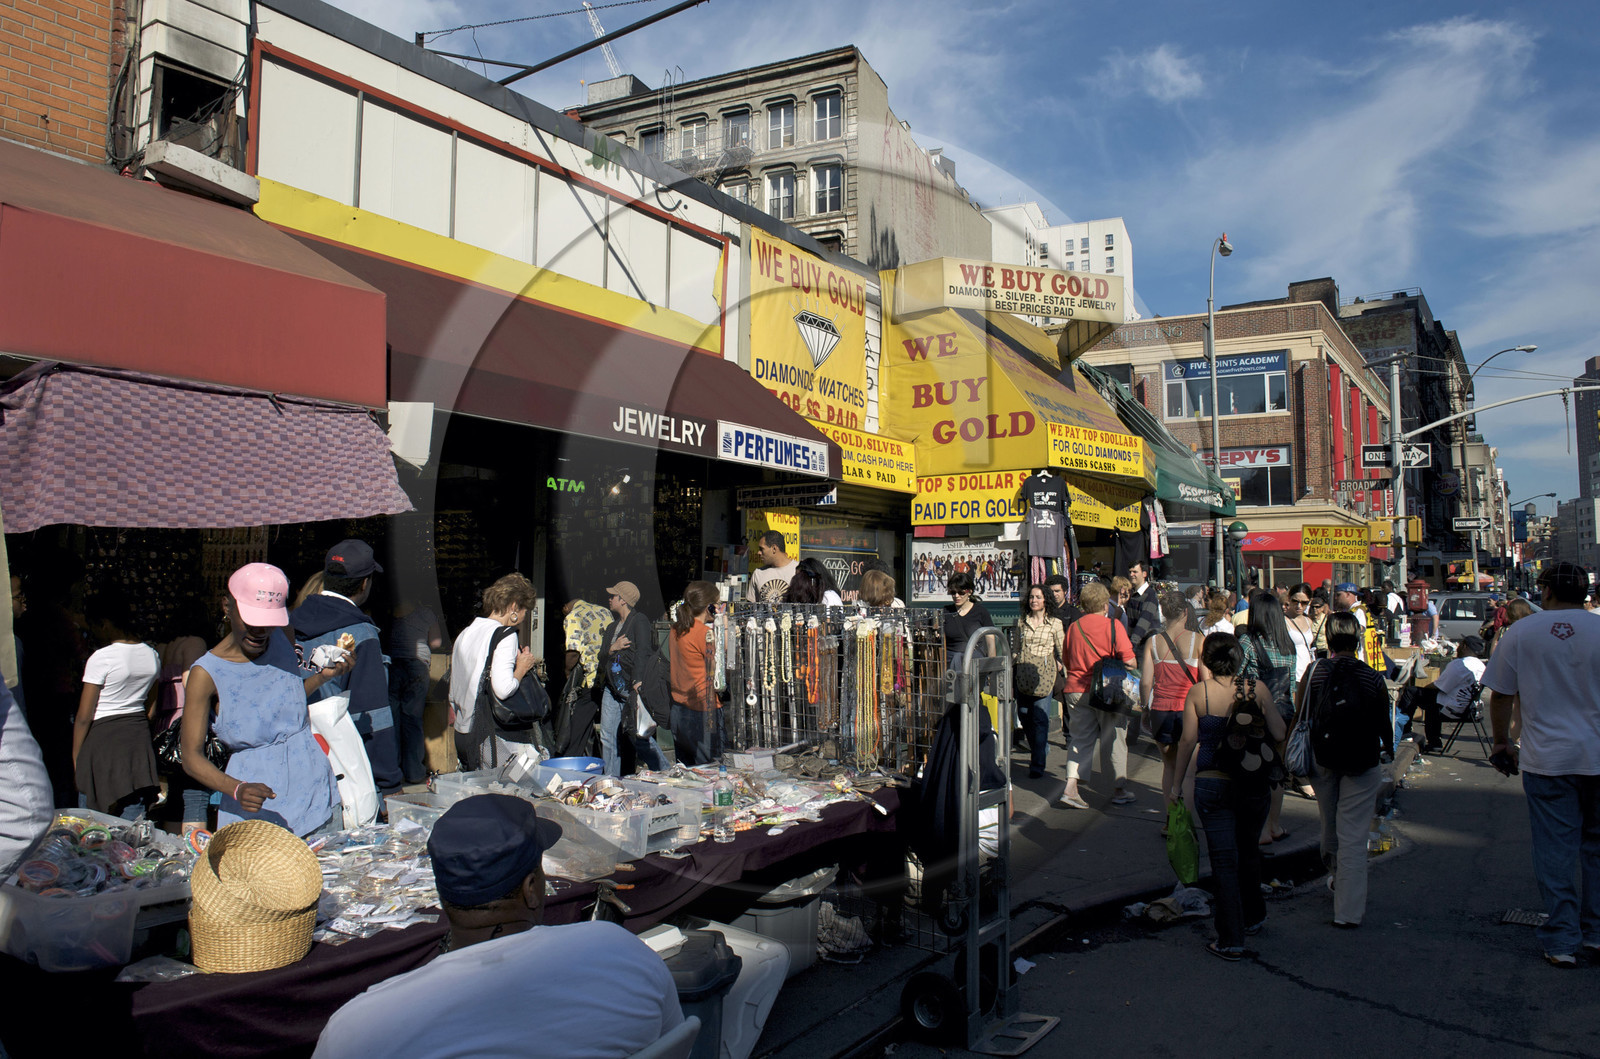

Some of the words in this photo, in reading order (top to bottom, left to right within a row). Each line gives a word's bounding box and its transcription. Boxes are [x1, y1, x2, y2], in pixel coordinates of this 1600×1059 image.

[756, 239, 784, 283] WE
[790, 254, 820, 297] BUY
[828, 271, 864, 316] GOLD
[959, 264, 995, 288] WE
[1001, 268, 1045, 293] BUY
[1051, 274, 1109, 299] GOLD
[949, 285, 998, 298] DIAMONDS
[1005, 291, 1036, 303] SILVER
[1043, 295, 1076, 307] ESTATE
[1078, 299, 1117, 311] JEWELRY
[995, 300, 1017, 311] BEST
[1020, 303, 1051, 314] PRICES
[1053, 307, 1074, 317] PAID
[902, 332, 958, 361] WE
[1190, 362, 1207, 370] FIVE
[1209, 359, 1238, 369] OINTS
[1239, 355, 1280, 366] ACADEMY
[756, 358, 815, 392] DIAMONDS
[819, 376, 865, 408] WATCHES
[912, 377, 988, 408] BUY
[612, 406, 707, 447] JEWELRY
[827, 404, 858, 430] PAID
[932, 411, 1036, 444] GOLD
[1050, 423, 1063, 437] WE
[1065, 426, 1081, 439] PAY
[1083, 429, 1098, 441] TOP
[734, 430, 810, 470] PERFUMES
[832, 430, 904, 457] GOLD,SILVER
[1053, 439, 1070, 453] FOR
[1072, 442, 1094, 456] GOLD
[1095, 446, 1132, 462] DIAMONDS
[841, 449, 856, 463] UM,
[856, 453, 877, 466] CASH
[879, 457, 895, 469] PAID
[896, 461, 914, 473] HERE
[1368, 452, 1386, 460] ONE
[1403, 452, 1423, 460] WAY
[547, 476, 586, 493] ATM
[842, 465, 864, 478] LLAR
[876, 471, 896, 484] PAID
[917, 478, 942, 493] TOP
[947, 476, 955, 493] $
[959, 473, 1013, 491] DOLLAR
[742, 485, 830, 498] PERFUMES
[1340, 480, 1386, 491] BROADWAY
[738, 498, 792, 509] WHOLESALE
[800, 495, 836, 506] RETAIL
[914, 502, 946, 521] PAID
[951, 500, 980, 519] FOR
[985, 498, 1027, 517] GOLD
[1120, 516, 1133, 527] SPOT
[1303, 537, 1326, 545] Gold
[1327, 538, 1368, 546] Diamonds
[1307, 528, 1329, 538] WE
[1334, 528, 1366, 538] BUY
[1302, 545, 1339, 554] Platinum
[1341, 546, 1367, 555] Coins
